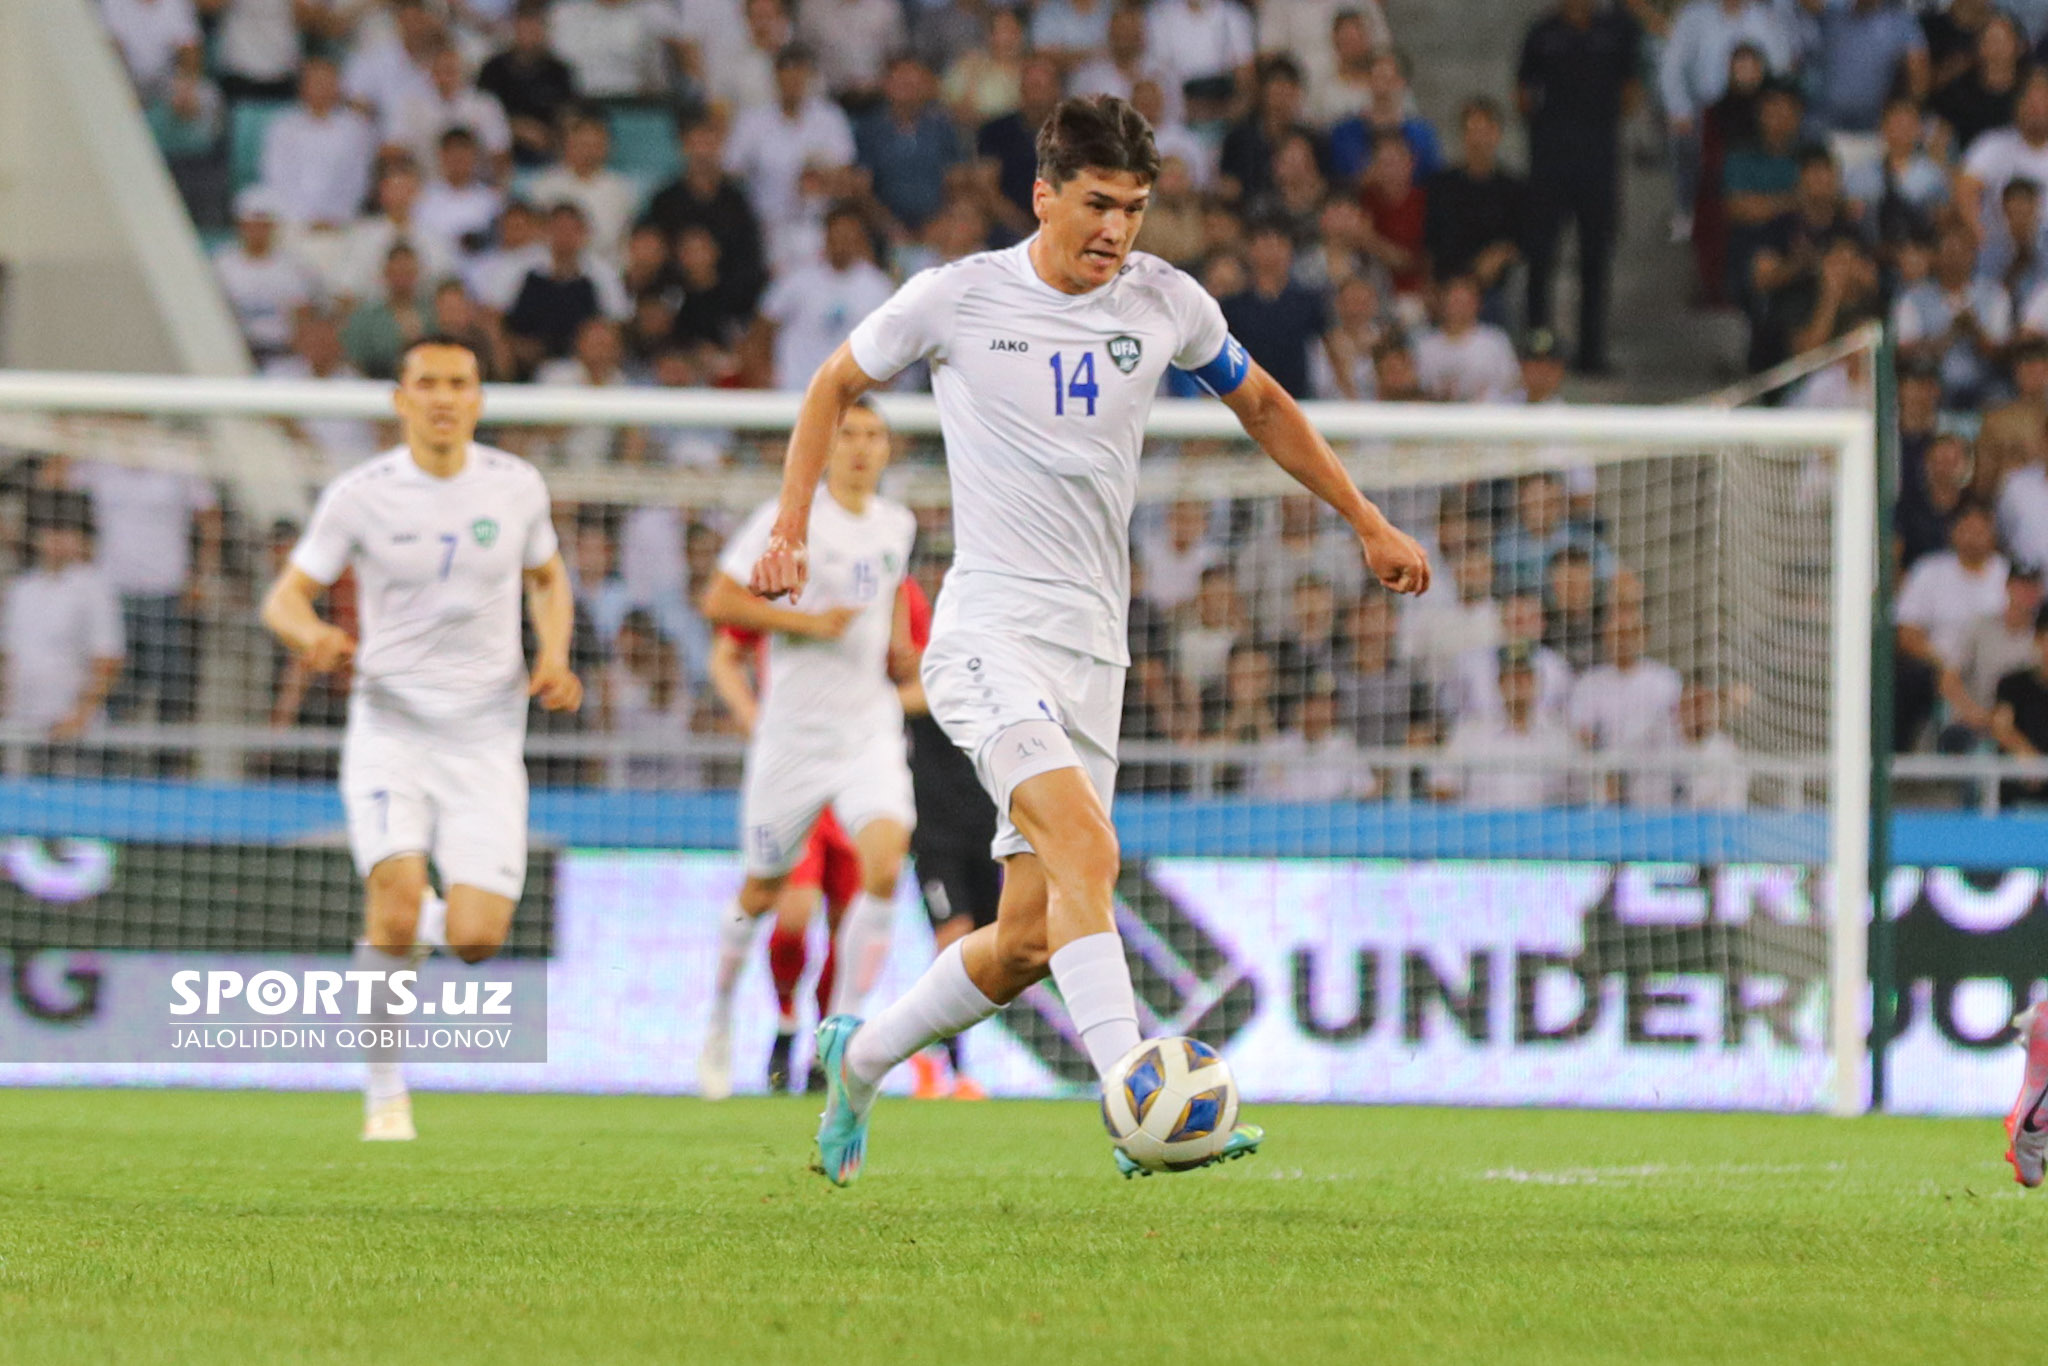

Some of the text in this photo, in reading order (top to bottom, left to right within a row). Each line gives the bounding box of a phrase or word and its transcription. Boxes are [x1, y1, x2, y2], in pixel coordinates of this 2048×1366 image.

[989, 339, 1029, 353] JAKO
[1111, 340, 1139, 356] UFA
[1050, 351, 1099, 416] 14
[439, 534, 457, 581] 7
[1016, 737, 1047, 758] 14
